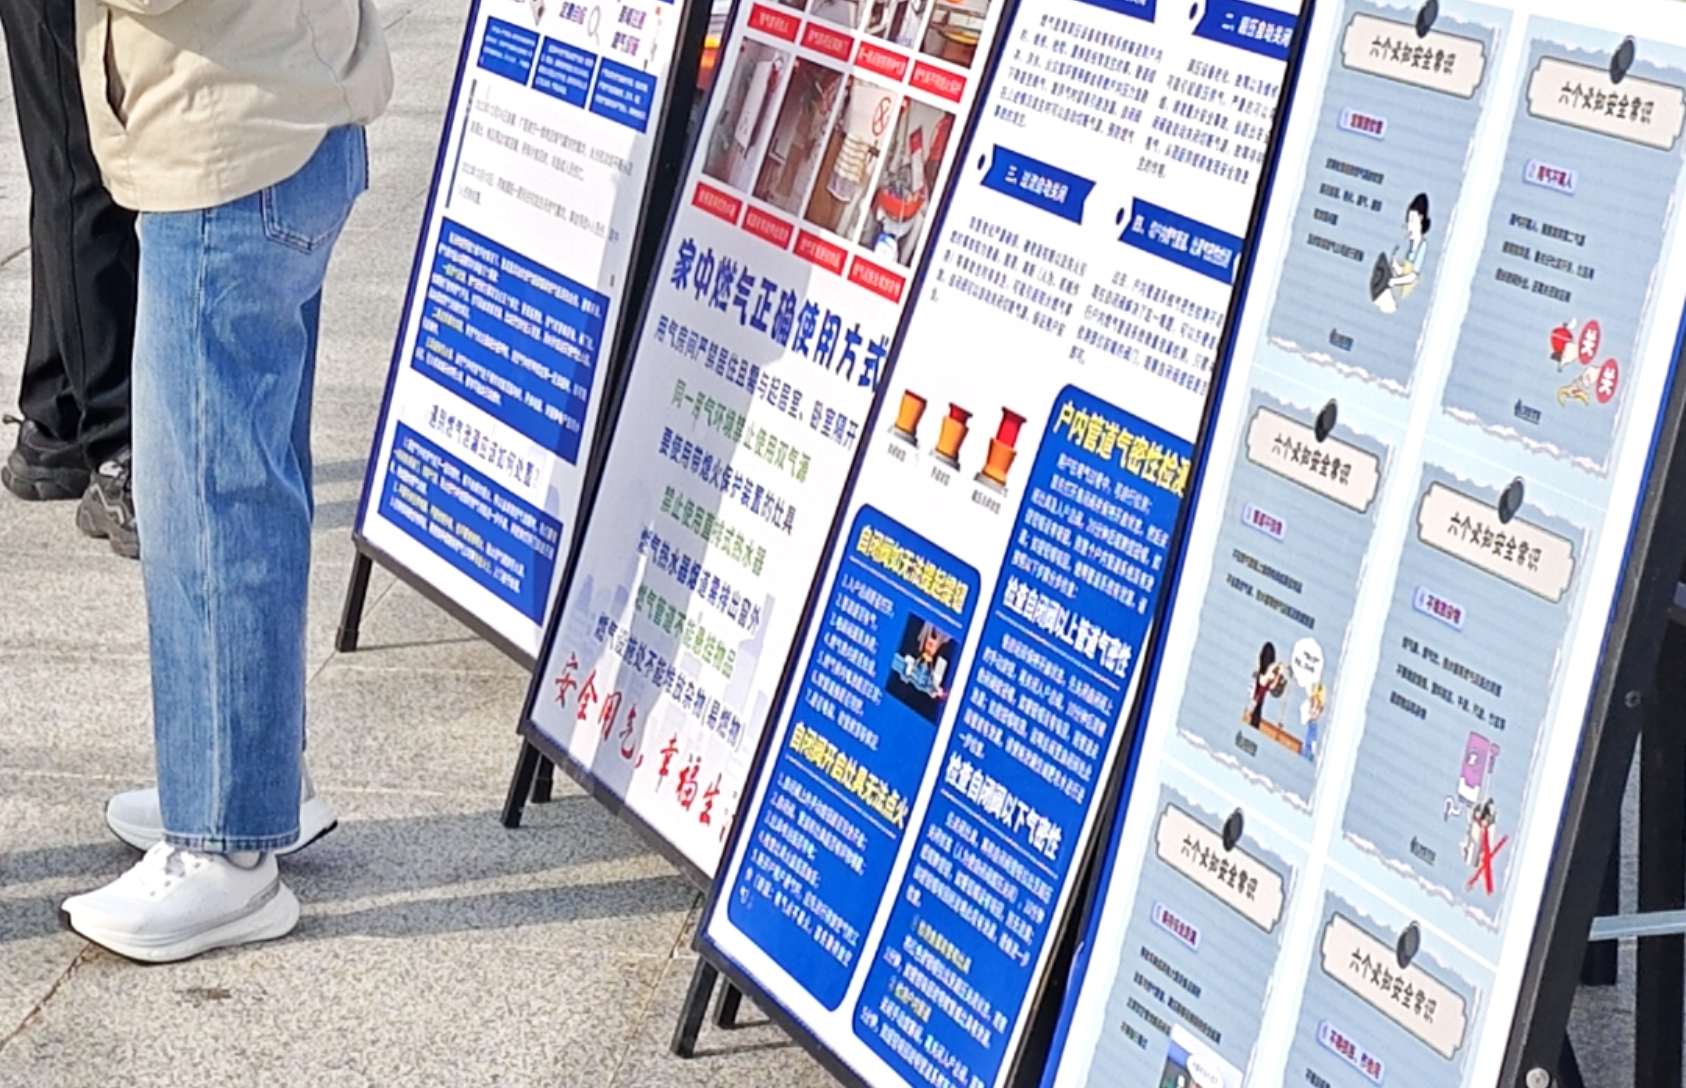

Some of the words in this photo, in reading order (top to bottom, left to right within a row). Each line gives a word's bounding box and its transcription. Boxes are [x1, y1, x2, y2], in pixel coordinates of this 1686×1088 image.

[1368, 33, 1457, 77] 六个必知安全常识
[1556, 78, 1655, 127] 六个必知安全常识
[670, 237, 888, 390] 家中燃气正确使用方式
[1579, 326, 1599, 359] 关
[1597, 366, 1617, 399] 关
[1270, 430, 1354, 487] 六个必知安全常识
[1446, 508, 1543, 574] 六个必知安全常识
[941, 748, 1065, 863] 检查自闭阀以下气密性
[1181, 833, 1258, 902] 六个必知安全常识
[1348, 948, 1437, 1024] 六个必知安全常识
